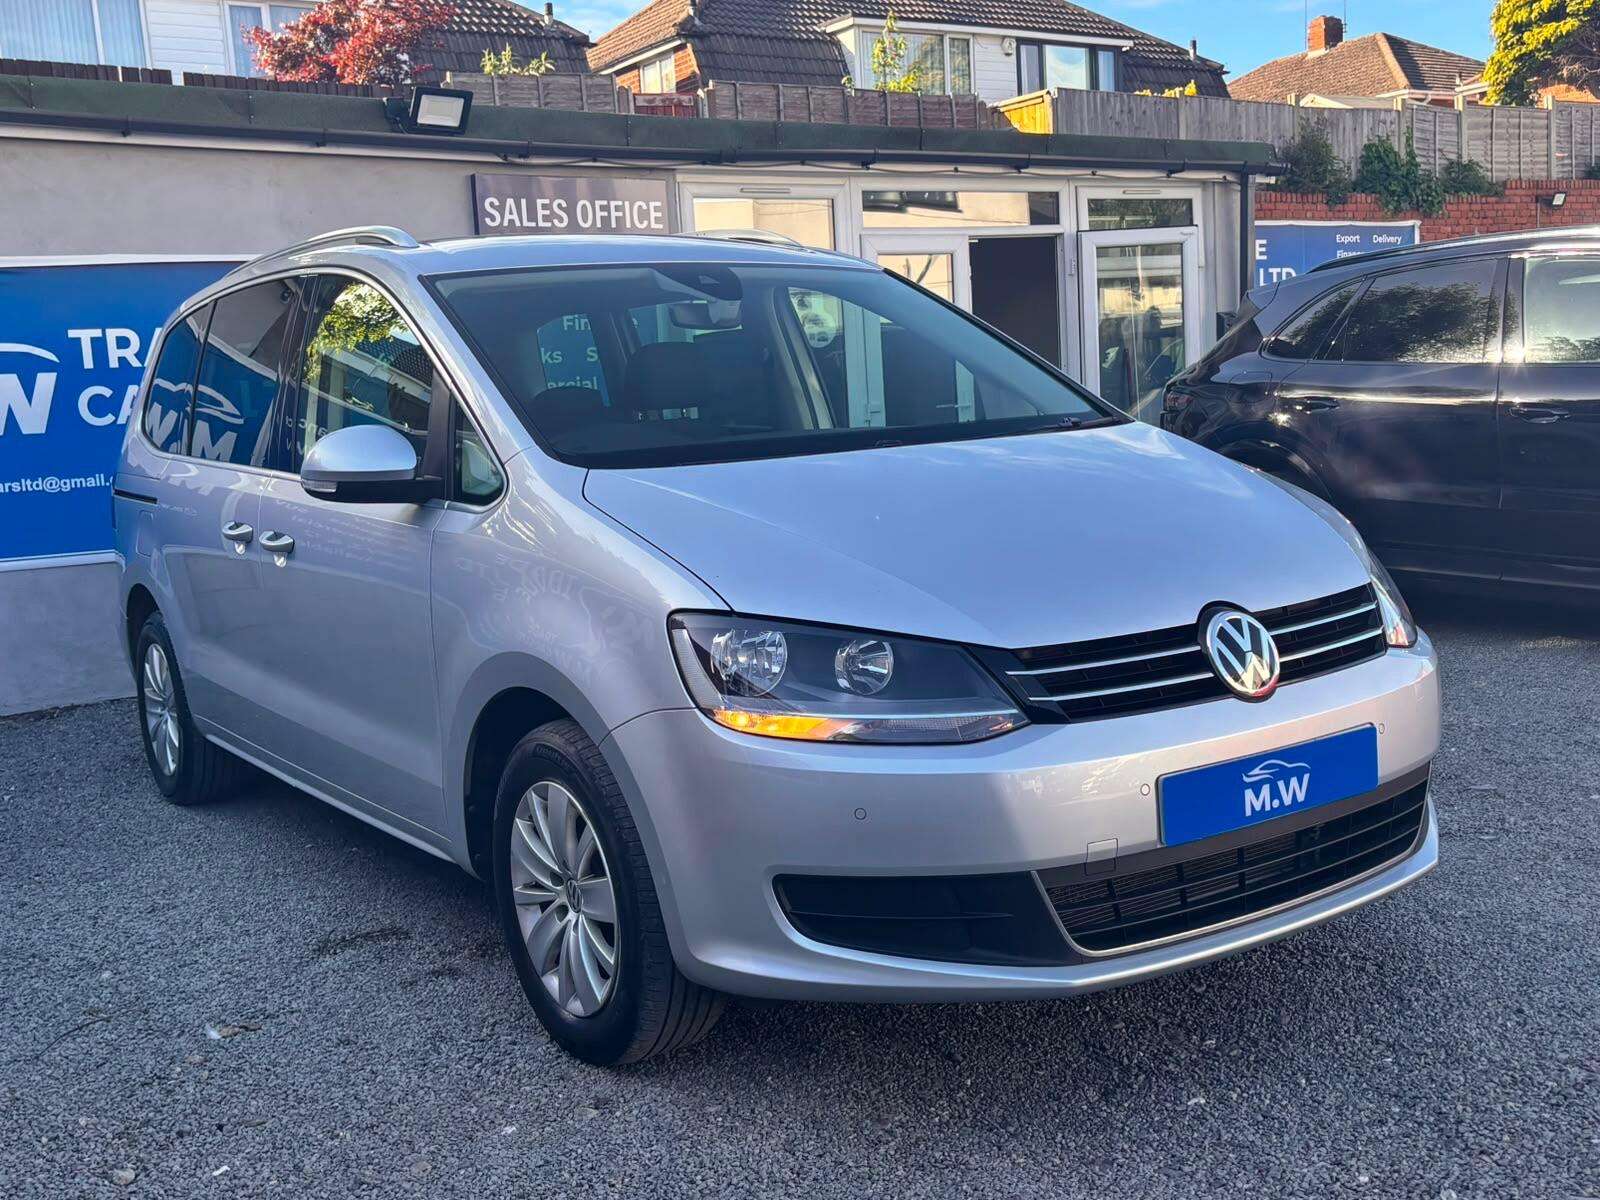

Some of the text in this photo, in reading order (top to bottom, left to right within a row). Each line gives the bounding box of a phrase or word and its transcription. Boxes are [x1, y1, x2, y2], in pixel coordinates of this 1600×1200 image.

[484, 197, 664, 229] SALES OFFICE
[1336, 234, 1402, 245] Export Delivery
[1243, 773, 1311, 817] M.W
